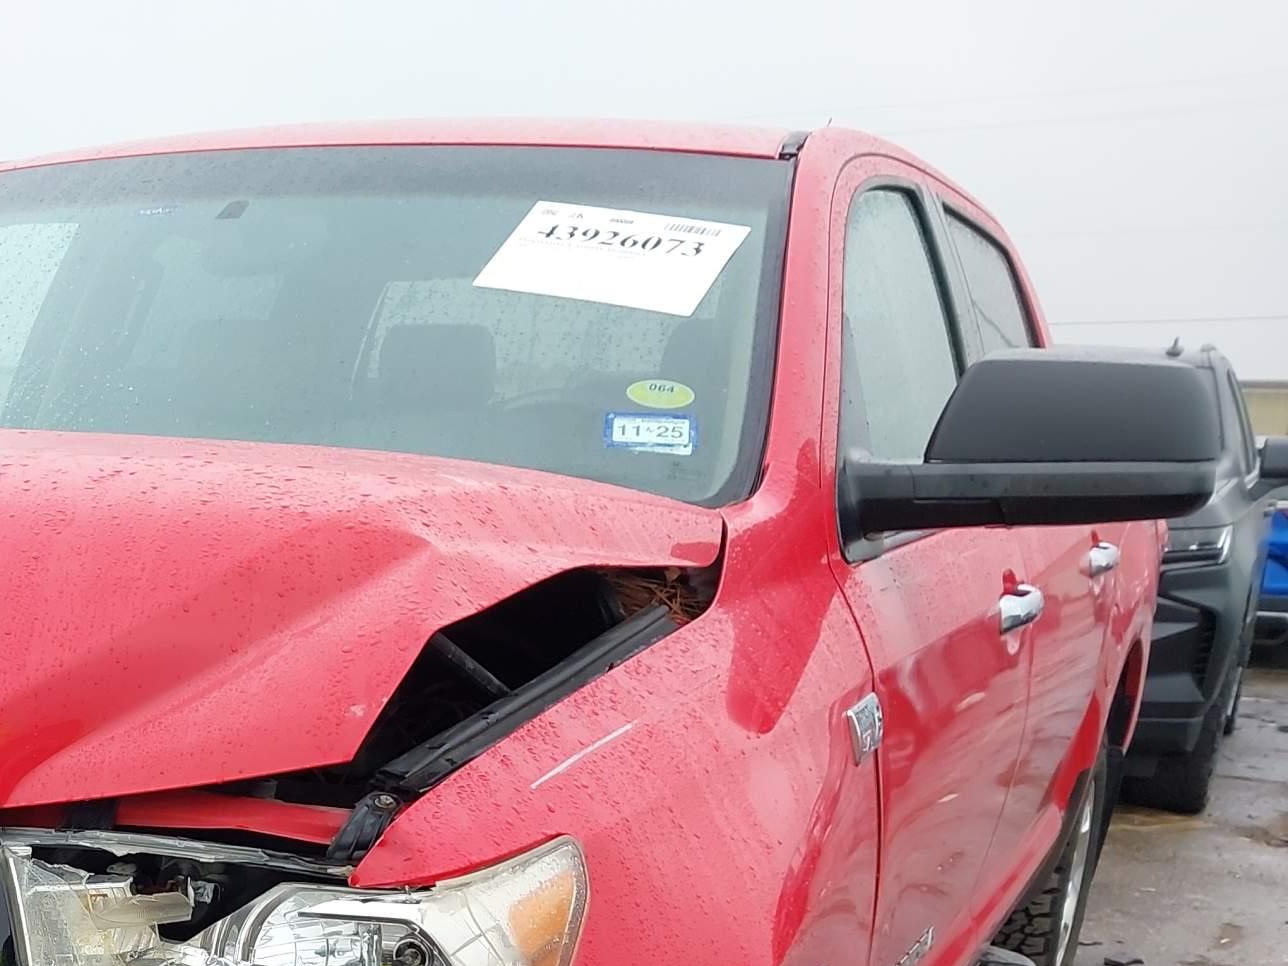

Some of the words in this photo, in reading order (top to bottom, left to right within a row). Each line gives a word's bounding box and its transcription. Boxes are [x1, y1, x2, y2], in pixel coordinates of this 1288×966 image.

[537, 224, 705, 257] 43926073
[648, 383, 674, 393] 064
[656, 425, 683, 439] 25
